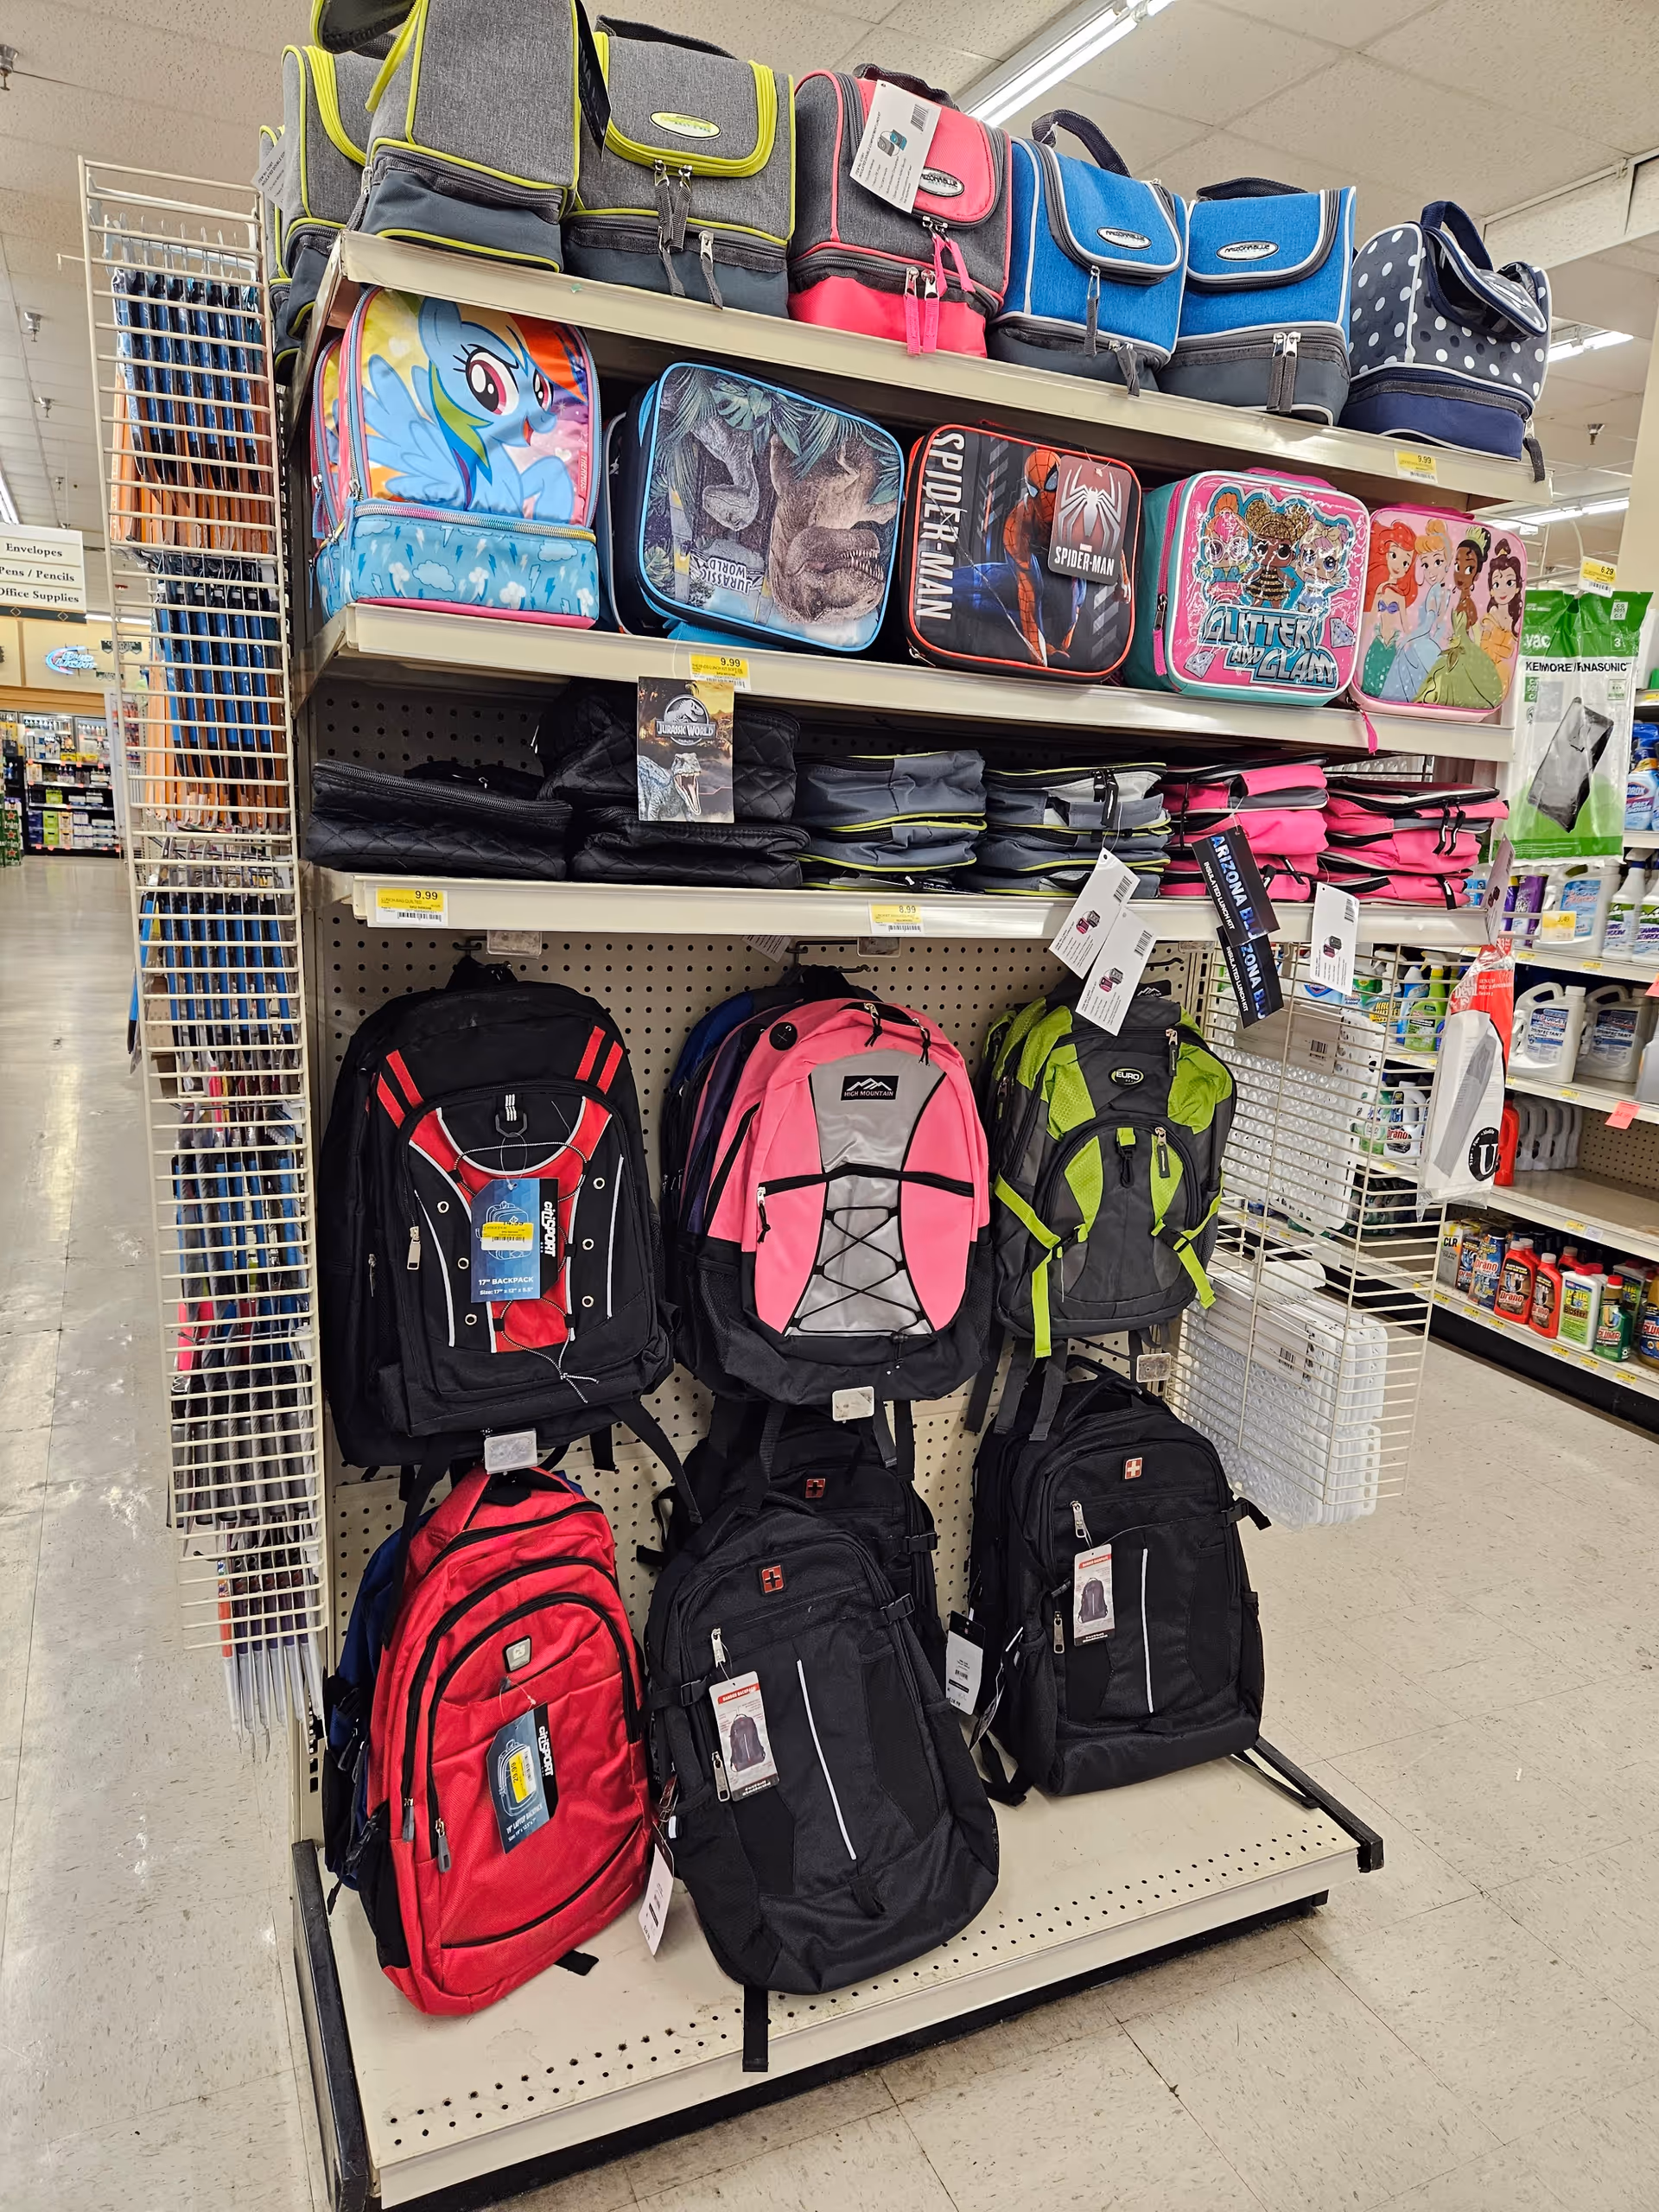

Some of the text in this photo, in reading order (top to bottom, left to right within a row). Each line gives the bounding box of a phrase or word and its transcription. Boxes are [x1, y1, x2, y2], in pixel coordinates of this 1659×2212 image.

[916, 432, 966, 620] SPIDER-MAN
[6, 543, 62, 557] Envelopes
[709, 559, 745, 578] WORLD
[1054, 546, 1115, 576] SPIDER-MAN
[0, 566, 24, 577] Pens
[36, 570, 74, 582] Pencils
[1601, 567, 1614, 575] 6.29
[700, 569, 750, 594] JURASSIC
[33, 591, 79, 603] Supplies
[1205, 607, 1313, 649] GLITTER
[721, 658, 741, 667] 9.99
[1231, 647, 1338, 683] AND GLAM
[658, 724, 714, 736] JURASSIC WORLD
[1211, 836, 1248, 907] ARIZONA
[415, 890, 437, 900] 9.99
[1204, 861, 1236, 930] INSULATED LUNCH KIT
[1241, 942, 1260, 988] ZONA
[1226, 946, 1240, 984] INSULATED
[1236, 982, 1246, 1004] LUNCH
[1116, 1071, 1140, 1080] EURO
[1479, 1143, 1498, 1176] U
[1444, 1237, 1459, 1248] CLR
[1475, 1258, 1498, 1272] Drano
[1500, 1291, 1524, 1303] Drano
[513, 1815, 525, 1830] LAPTOP
[525, 1802, 543, 1821] BACKPACK
